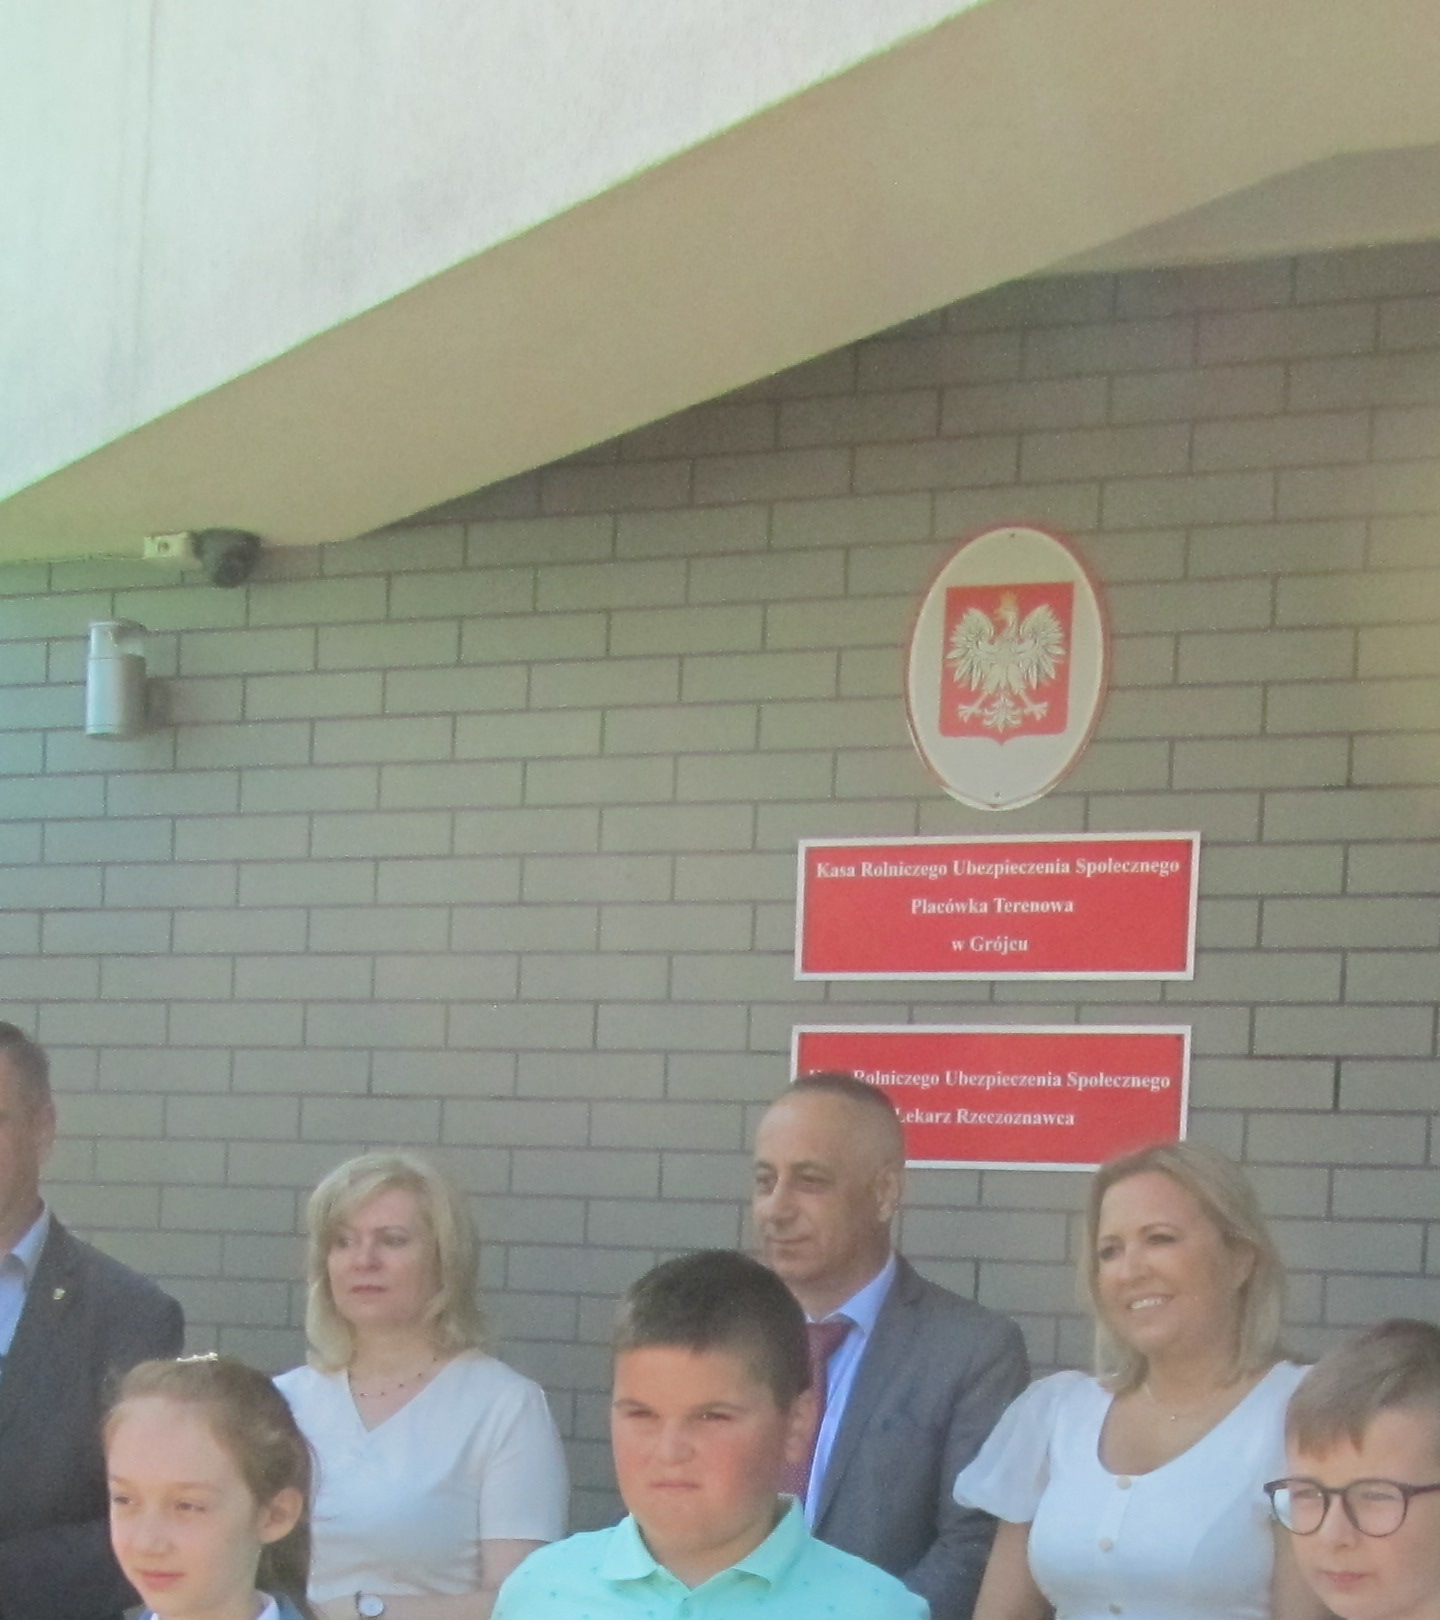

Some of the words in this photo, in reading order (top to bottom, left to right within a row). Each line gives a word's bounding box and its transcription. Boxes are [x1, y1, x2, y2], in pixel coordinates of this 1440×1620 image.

[816, 862, 856, 878] Kasa
[861, 861, 948, 880] Rolniczego
[953, 859, 1070, 879] Ubezpieczenia
[1075, 858, 1180, 878] Społecznego
[911, 897, 988, 915] Placówka
[993, 897, 1074, 913] Terenowa
[952, 940, 965, 951] w
[970, 936, 1029, 955] Grójcu
[945, 1070, 1062, 1090] Ubezpieczenia
[1066, 1072, 1171, 1092] Społecznego
[956, 1108, 1075, 1126] Rzeczoznawca
